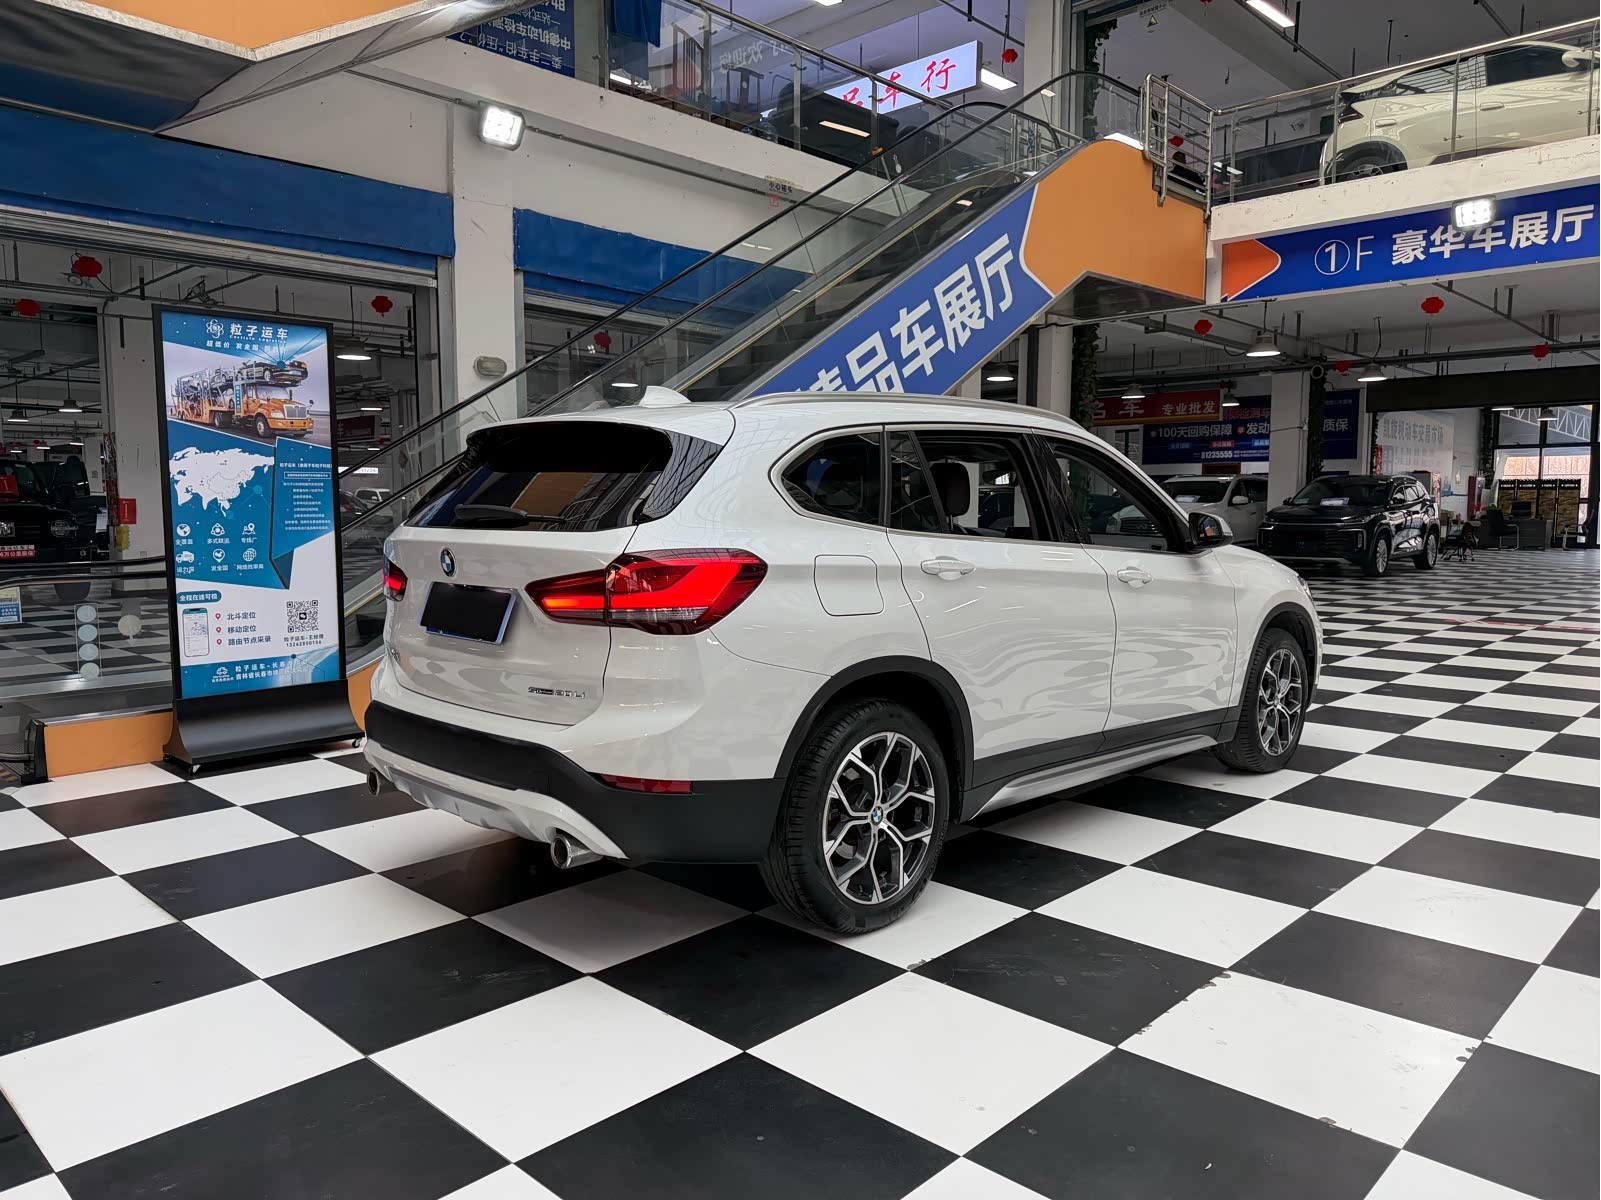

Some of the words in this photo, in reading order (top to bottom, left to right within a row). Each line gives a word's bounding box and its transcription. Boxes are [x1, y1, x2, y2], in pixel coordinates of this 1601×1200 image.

[485, 17, 572, 51] 中德机动车检测
[1391, 204, 1595, 267] 豪华车展厅
[230, 323, 289, 340] 粒子运车
[1161, 400, 1216, 416] 专业批发
[1158, 423, 1233, 438] 100天回购保障
[1322, 418, 1349, 432] 质保
[226, 612, 256, 621] 北斗定位
[227, 625, 257, 634] 移动定位
[227, 635, 272, 646] 路由节点采录
